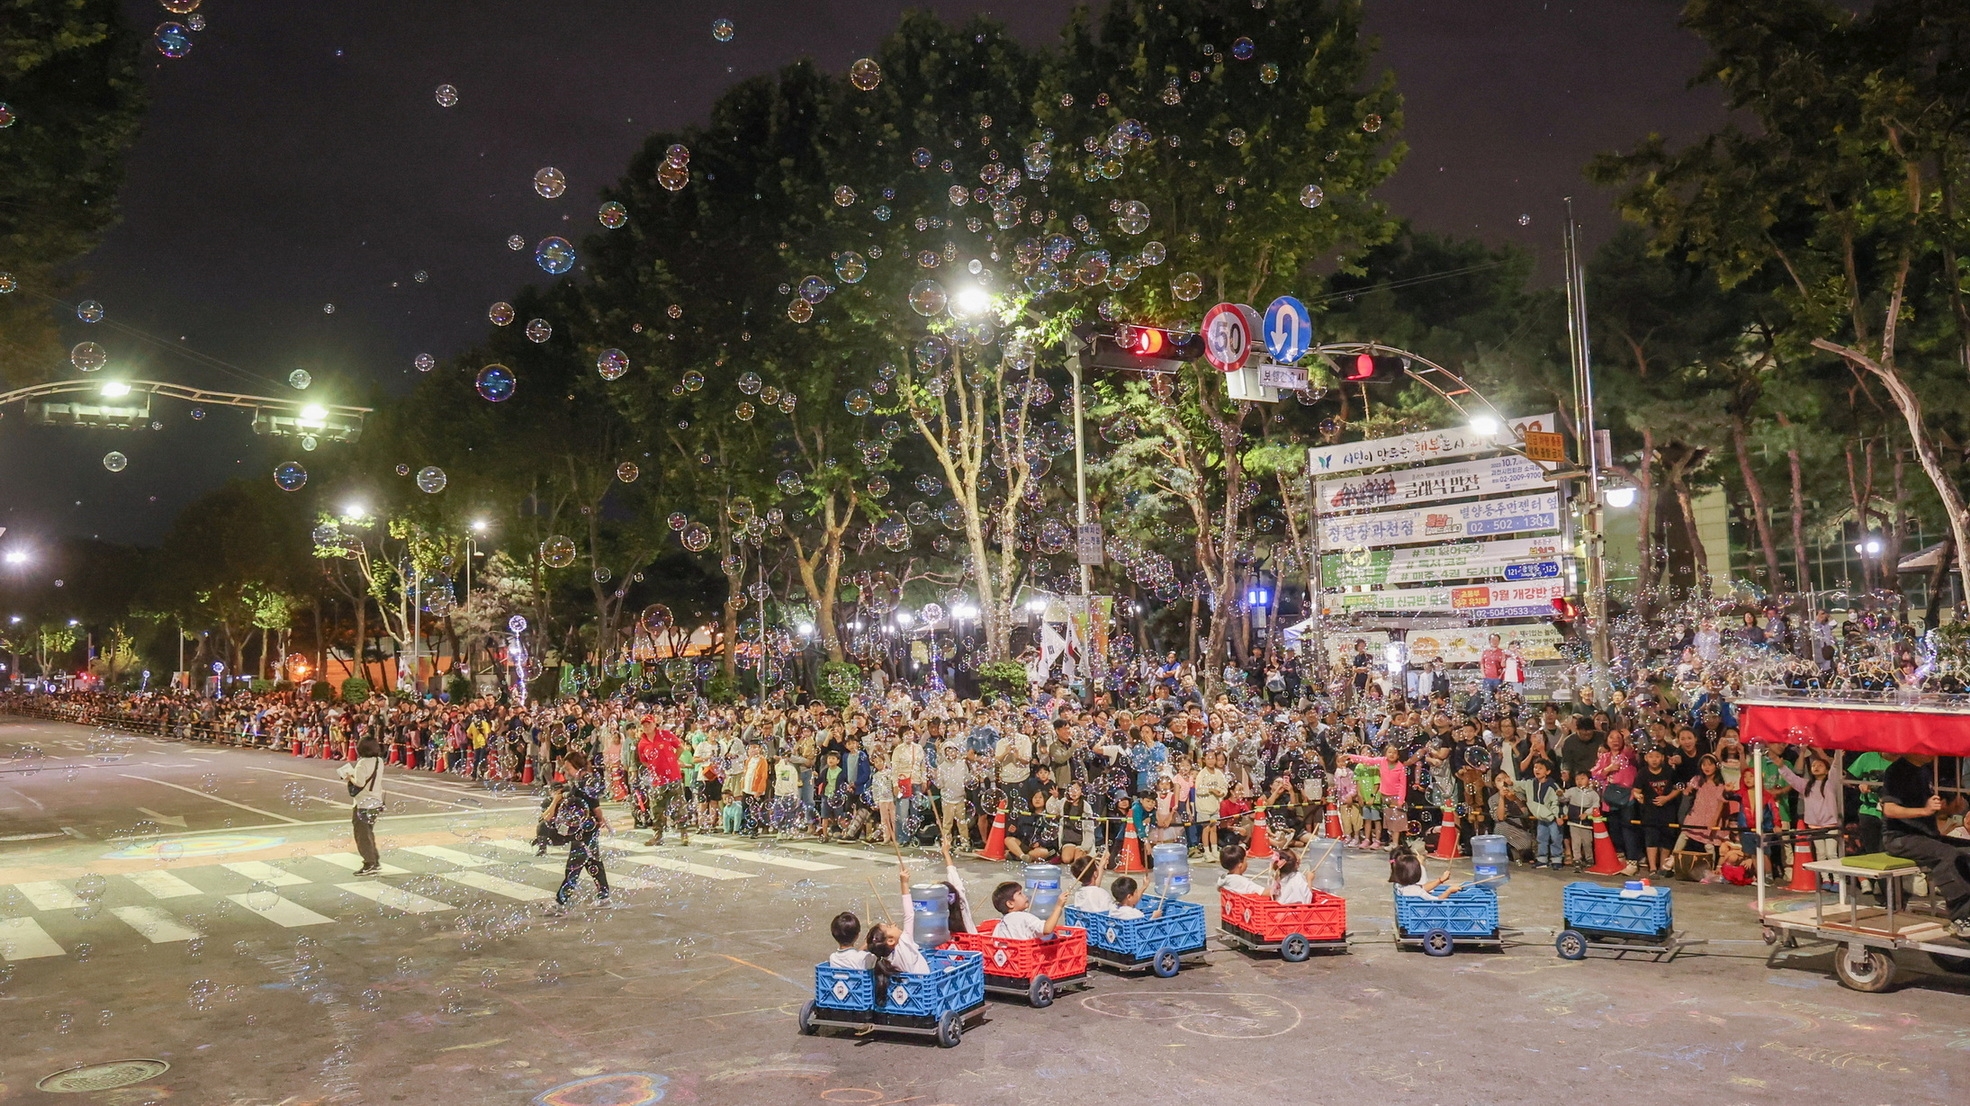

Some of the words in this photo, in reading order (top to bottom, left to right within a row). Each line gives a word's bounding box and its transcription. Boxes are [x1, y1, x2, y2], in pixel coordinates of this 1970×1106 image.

[1214, 321, 1241, 355] 50
[1343, 449, 1373, 465] 시민이
[1377, 447, 1410, 462] 만드는
[1500, 472, 1541, 482] 02-2009-9700
[1405, 479, 1447, 498] 클래식
[1451, 474, 1480, 493] 만찬
[1466, 567, 1489, 576] 도서
[1508, 568, 1517, 576] 121
[1546, 565, 1557, 573] 125
[1492, 590, 1509, 601] 9월
[1513, 587, 1547, 600] 개강반
[1551, 586, 1564, 597] 모
[1476, 607, 1529, 617] 02-504-0533
